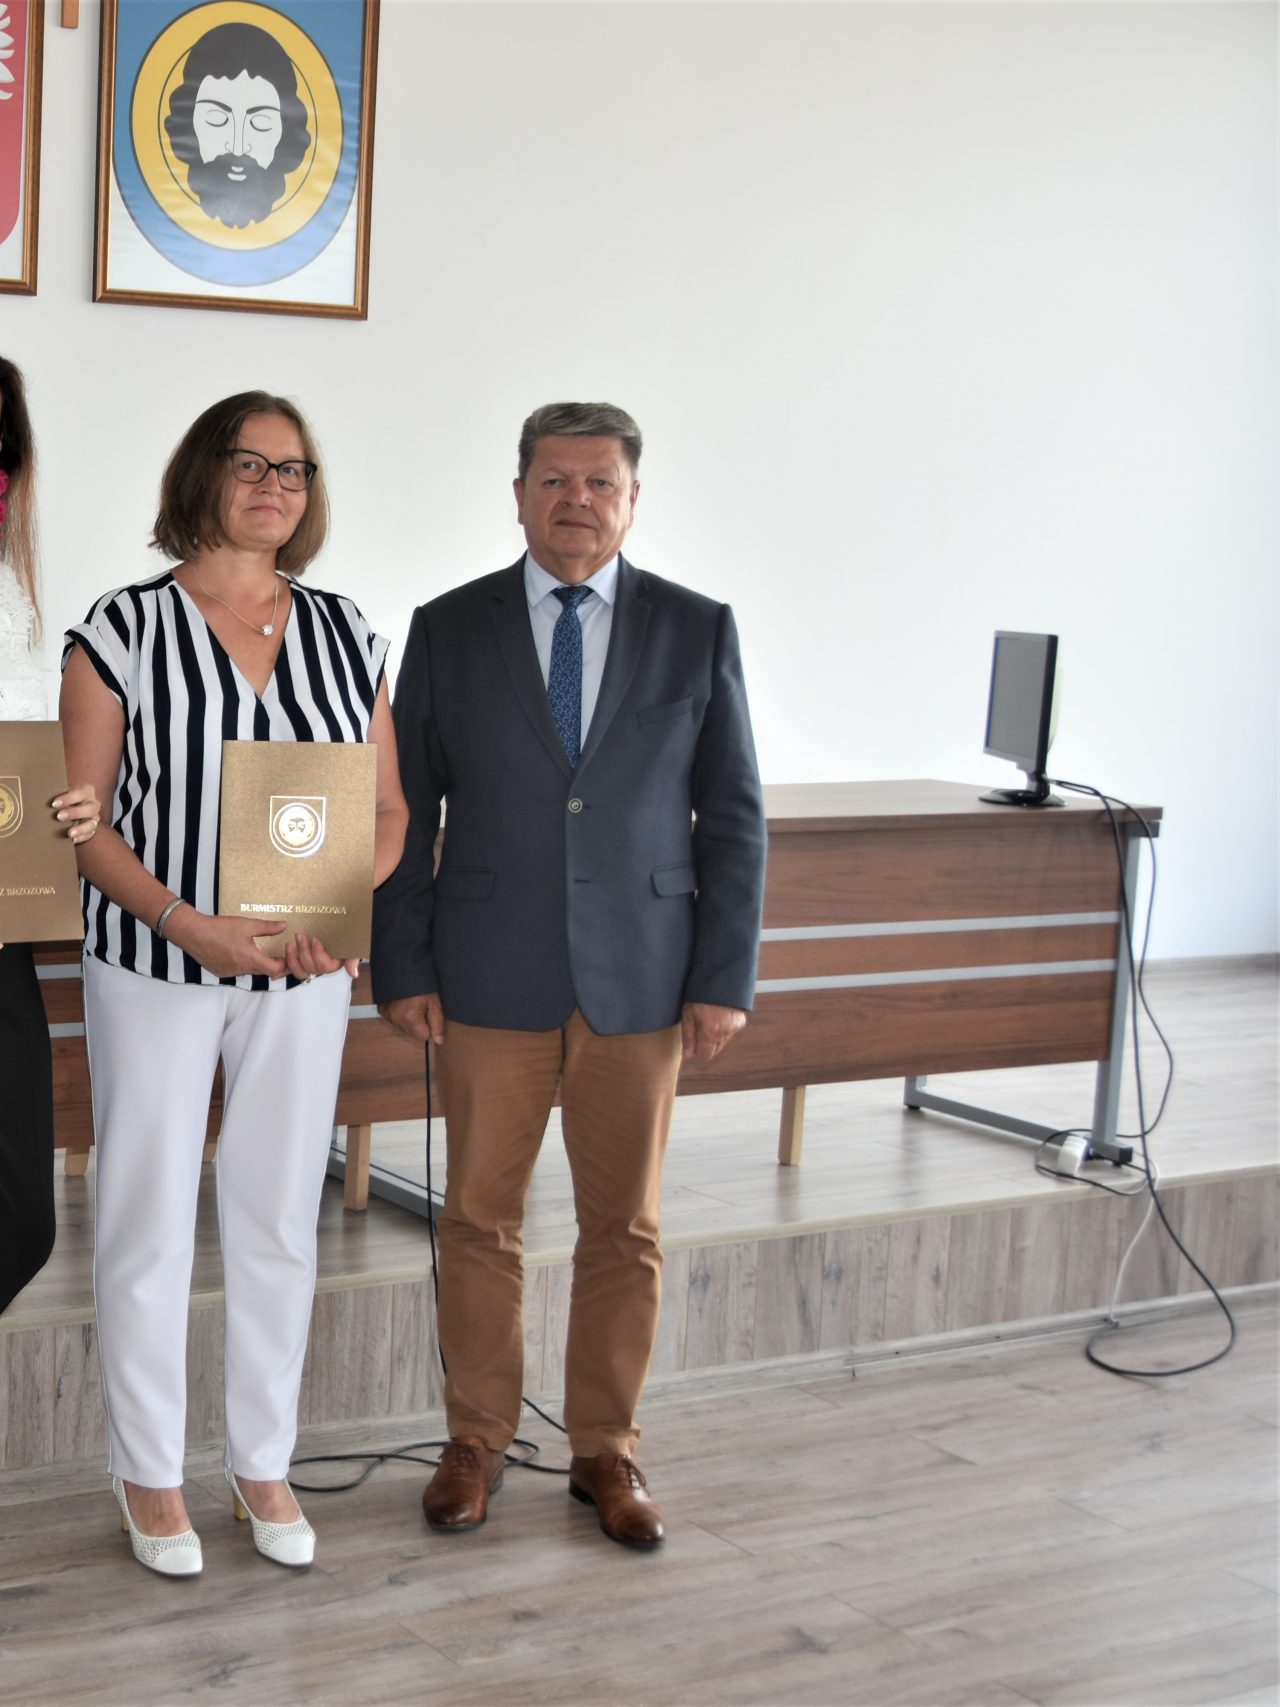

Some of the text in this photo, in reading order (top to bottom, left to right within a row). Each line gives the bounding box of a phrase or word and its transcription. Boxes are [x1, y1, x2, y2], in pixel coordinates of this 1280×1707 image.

[6, 886, 56, 896] BRZOZOWA
[240, 903, 347, 915] BURMISTRZ BRZOZOWA
